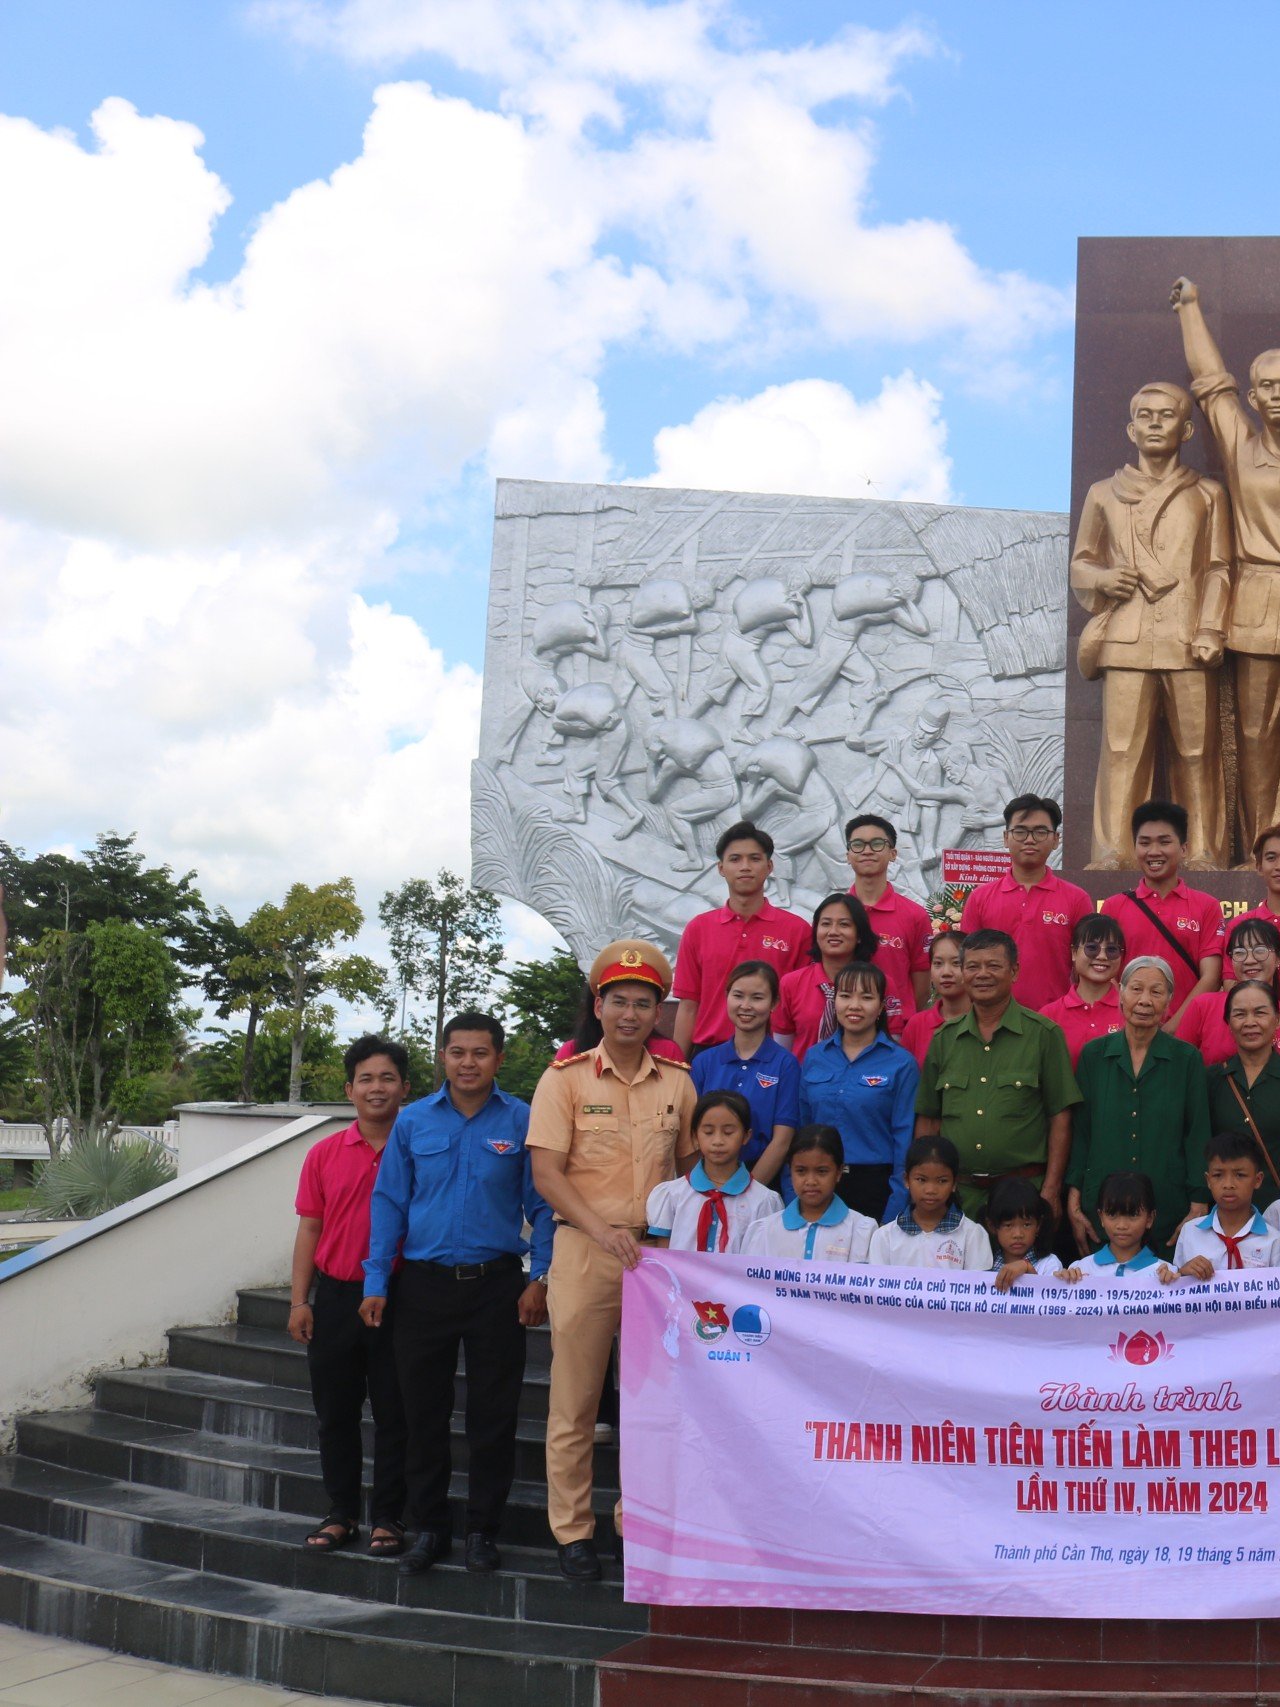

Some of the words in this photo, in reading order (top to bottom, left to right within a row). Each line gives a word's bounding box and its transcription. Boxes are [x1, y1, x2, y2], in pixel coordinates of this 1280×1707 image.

[747, 1267, 771, 1280] CHÀO
[774, 1269, 801, 1282] MỪNG
[806, 1273, 821, 1283] 134
[825, 1274, 846, 1286] NĂM
[849, 1275, 875, 1287] NGÀY
[878, 1278, 901, 1289] SINH
[904, 1277, 923, 1291] CỦA
[927, 1279, 946, 1293] CHỦ
[950, 1282, 970, 1295] TỊCH
[974, 1281, 987, 1295] HỒ
[1010, 1286, 1034, 1298] MINH
[1041, 1288, 1097, 1301] (19/5/1890
[1169, 1289, 1186, 1297] 113
[1189, 1285, 1210, 1294] NĂM
[1214, 1280, 1240, 1293] NGÀY
[1244, 1280, 1263, 1292] BÁC
[1267, 1277, 1280, 1291] HỒ
[776, 1287, 787, 1298] 55
[790, 1288, 811, 1299] NĂM
[813, 1291, 838, 1302] THỰC
[840, 1292, 861, 1304] HIỆN
[864, 1295, 874, 1305] DI
[877, 1295, 902, 1307] CHÚC
[905, 1295, 924, 1309] CỦA
[927, 1298, 946, 1311] CHỦ
[950, 1301, 971, 1313] TỊCH
[975, 1300, 988, 1313] HỒ
[991, 1302, 1008, 1314] CHÍ
[1010, 1304, 1035, 1315] MINH
[1038, 1305, 1066, 1316] (1969
[1075, 1306, 1103, 1316] 2024)
[1107, 1304, 1120, 1315] VÀ
[1153, 1302, 1182, 1315] MỪNG
[1185, 1303, 1201, 1314] ĐẠI
[1205, 1300, 1222, 1314] HỘI
[1225, 1301, 1241, 1312] ĐẠI
[1245, 1295, 1267, 1310] BIỂU
[708, 1350, 740, 1363] QUẬN
[746, 1352, 751, 1362] 1
[1040, 1382, 1146, 1412] Hành
[1153, 1381, 1243, 1412] trình
[911, 1419, 977, 1465] NIÊN
[983, 1421, 1044, 1467] TIÊN
[1052, 1418, 1113, 1468] TIẾN
[1122, 1423, 1181, 1469] LÀM
[1189, 1428, 1258, 1469] THEO
[1016, 1472, 1058, 1513] LẦN
[1065, 1476, 1108, 1513] THỨ
[1113, 1481, 1142, 1516] IV,
[1147, 1476, 1201, 1513] NĂM
[1208, 1481, 1268, 1513] 2024
[994, 1544, 1031, 1560] Thành
[1034, 1543, 1058, 1563] phố
[1062, 1543, 1086, 1561] Cần
[1090, 1546, 1114, 1563] Thơ,
[1119, 1546, 1150, 1565] ngày
[1155, 1546, 1172, 1564] 18,
[1178, 1546, 1193, 1562] 19
[1197, 1547, 1233, 1565] tháng
[1236, 1547, 1245, 1562] 5
[1248, 1548, 1276, 1562] năm
